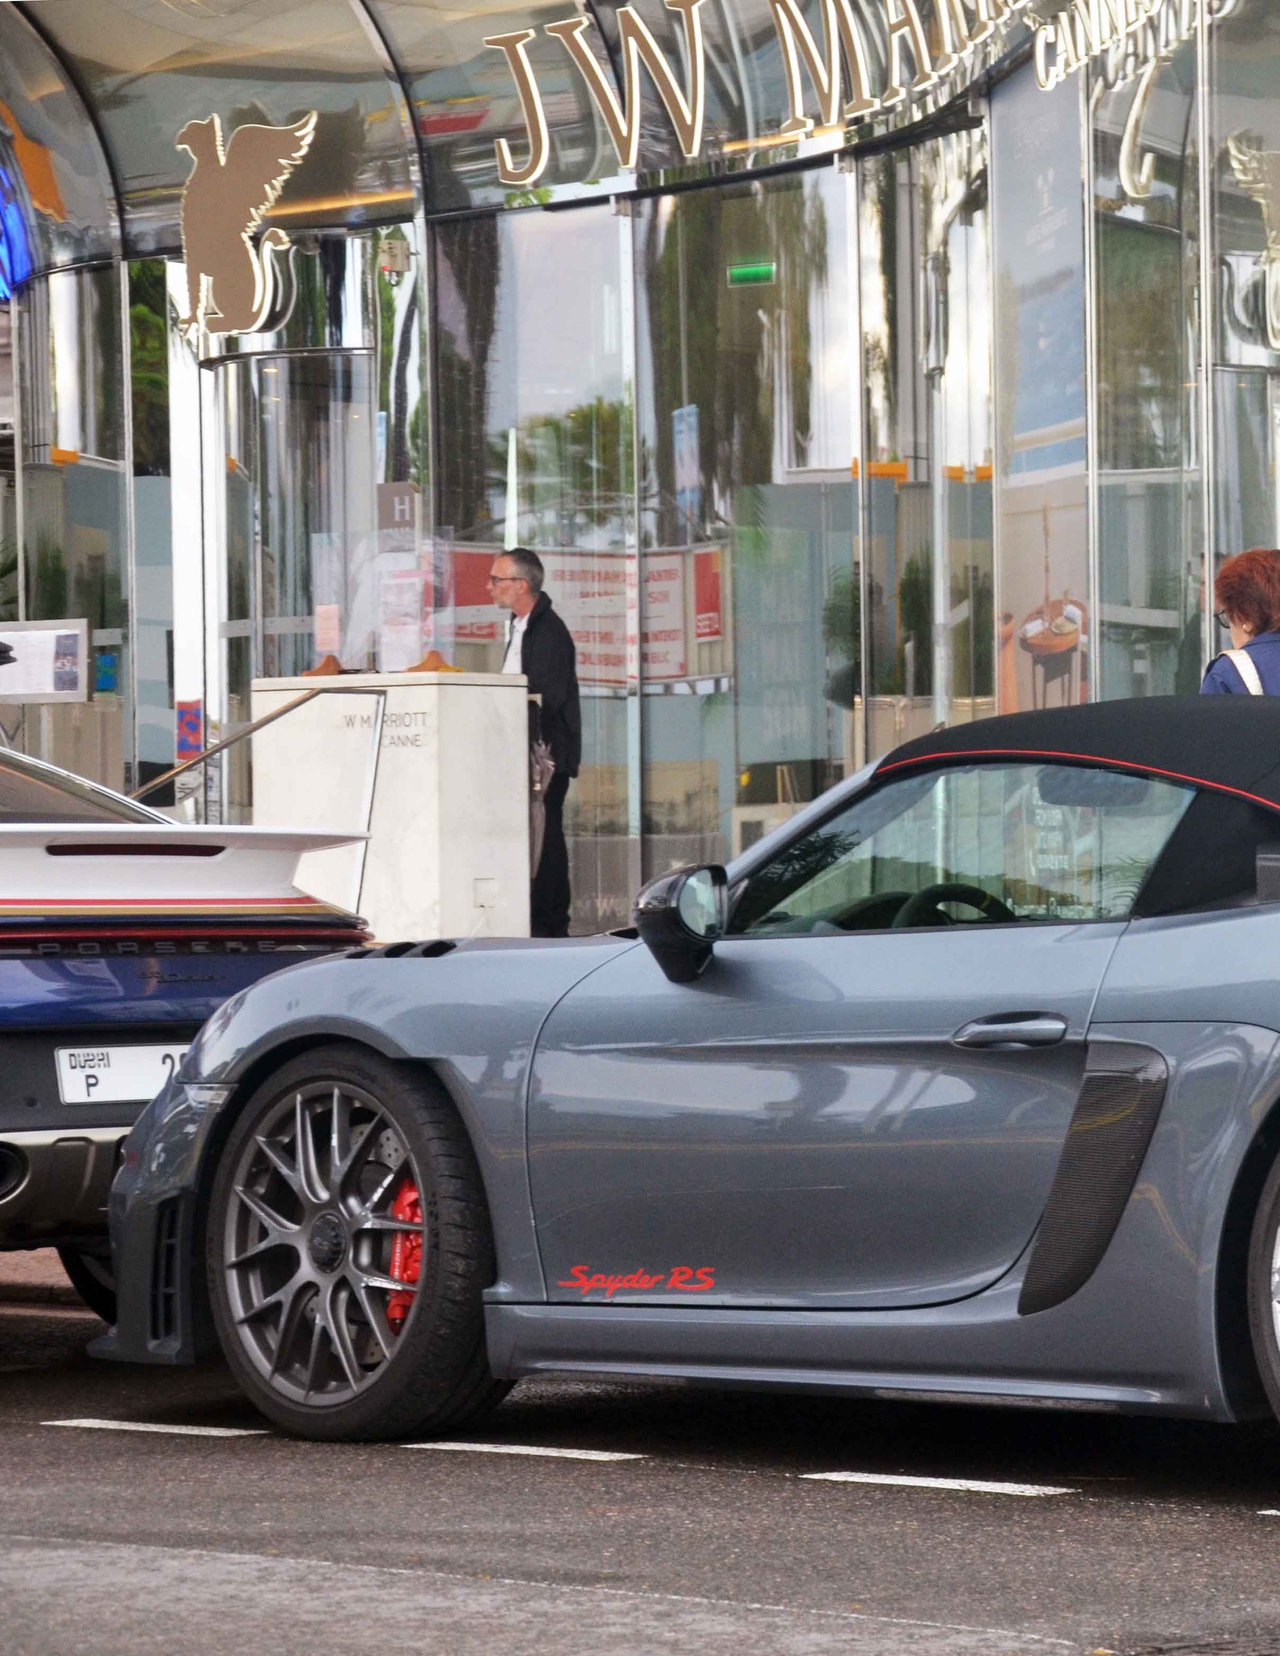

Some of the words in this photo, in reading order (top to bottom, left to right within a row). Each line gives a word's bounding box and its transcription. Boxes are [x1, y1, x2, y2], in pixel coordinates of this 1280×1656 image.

[483, 0, 707, 185] JW
[394, 496, 410, 521] H
[360, 711, 428, 729] MRRIOTT
[379, 733, 428, 748] CANNE
[84, 1074, 99, 1098] P
[557, 1264, 665, 1299] Spyder
[666, 1265, 716, 1292] RS
